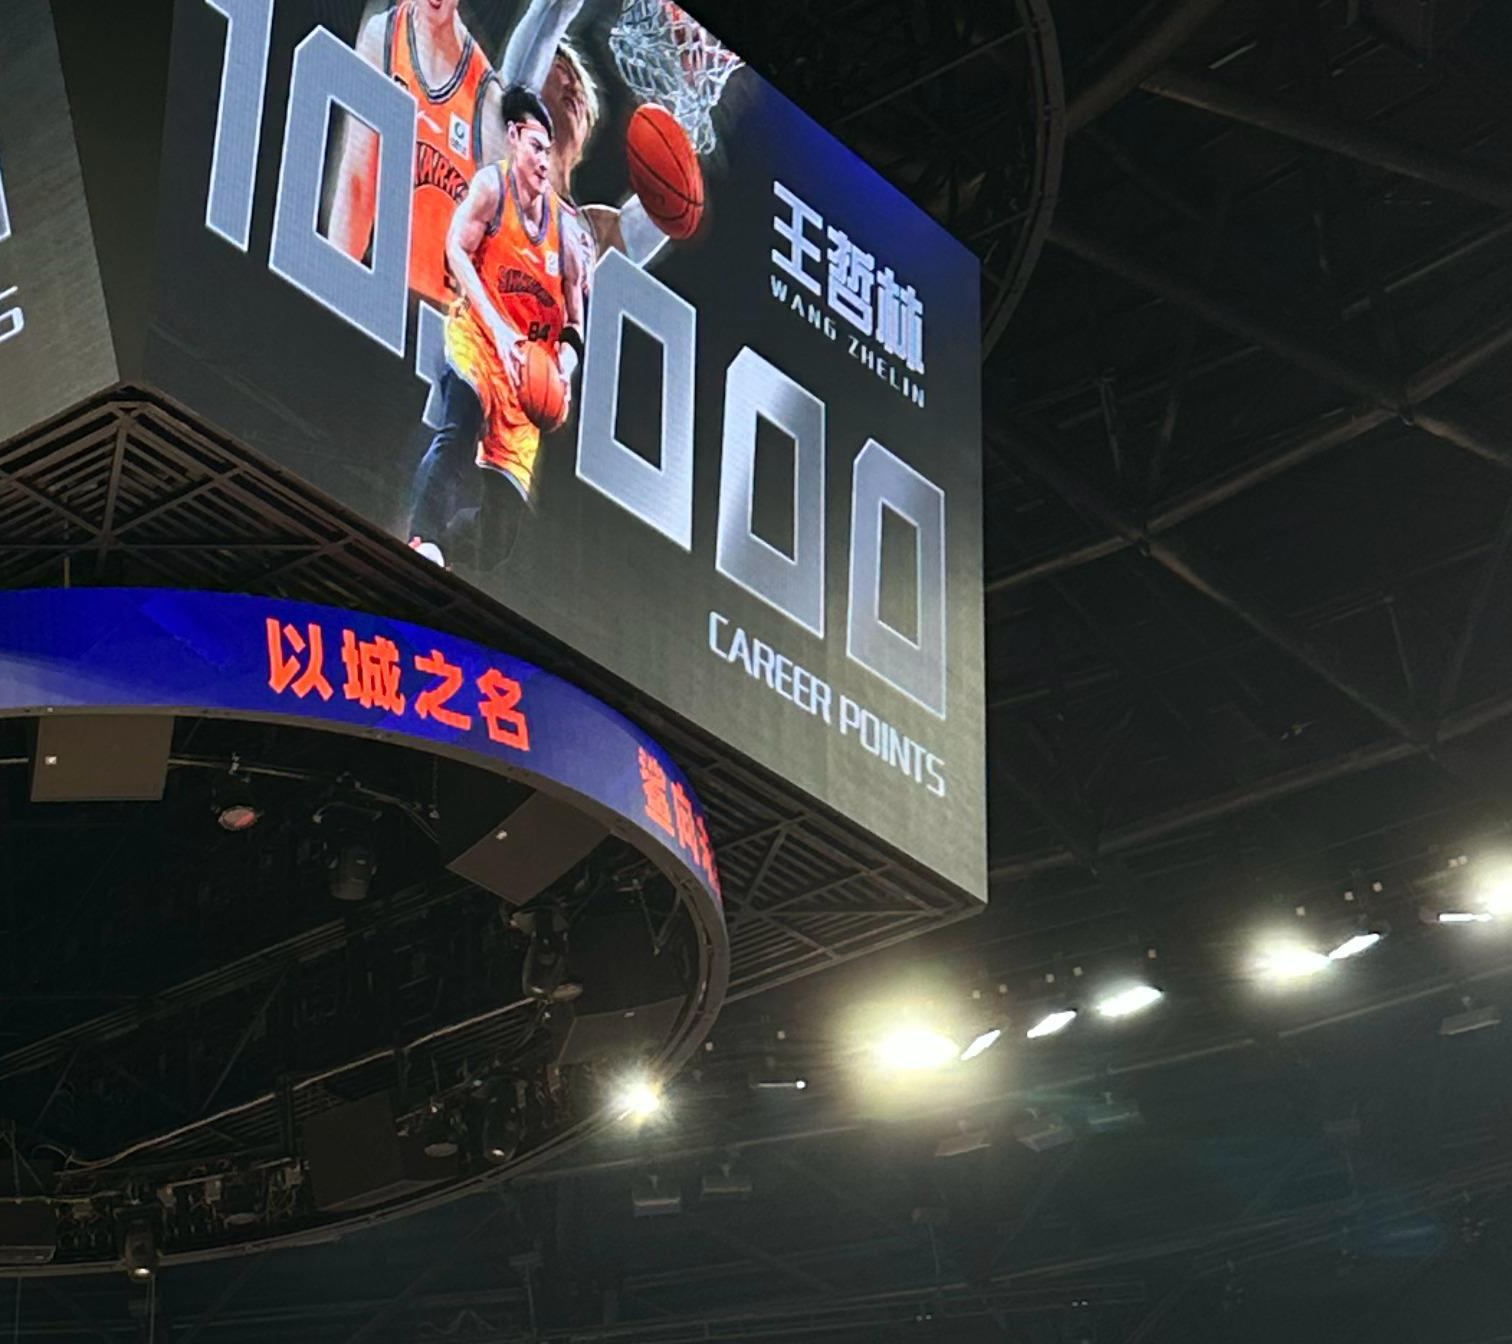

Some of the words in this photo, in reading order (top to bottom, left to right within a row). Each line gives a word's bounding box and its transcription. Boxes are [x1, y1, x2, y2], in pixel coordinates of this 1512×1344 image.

[770, 274, 837, 342] WANG
[847, 334, 926, 408] ZHELIN
[772, 181, 925, 375] 王哲林
[266, 616, 531, 754] 以城之名
[709, 611, 831, 727] CAREER
[839, 694, 946, 798] POINTS
